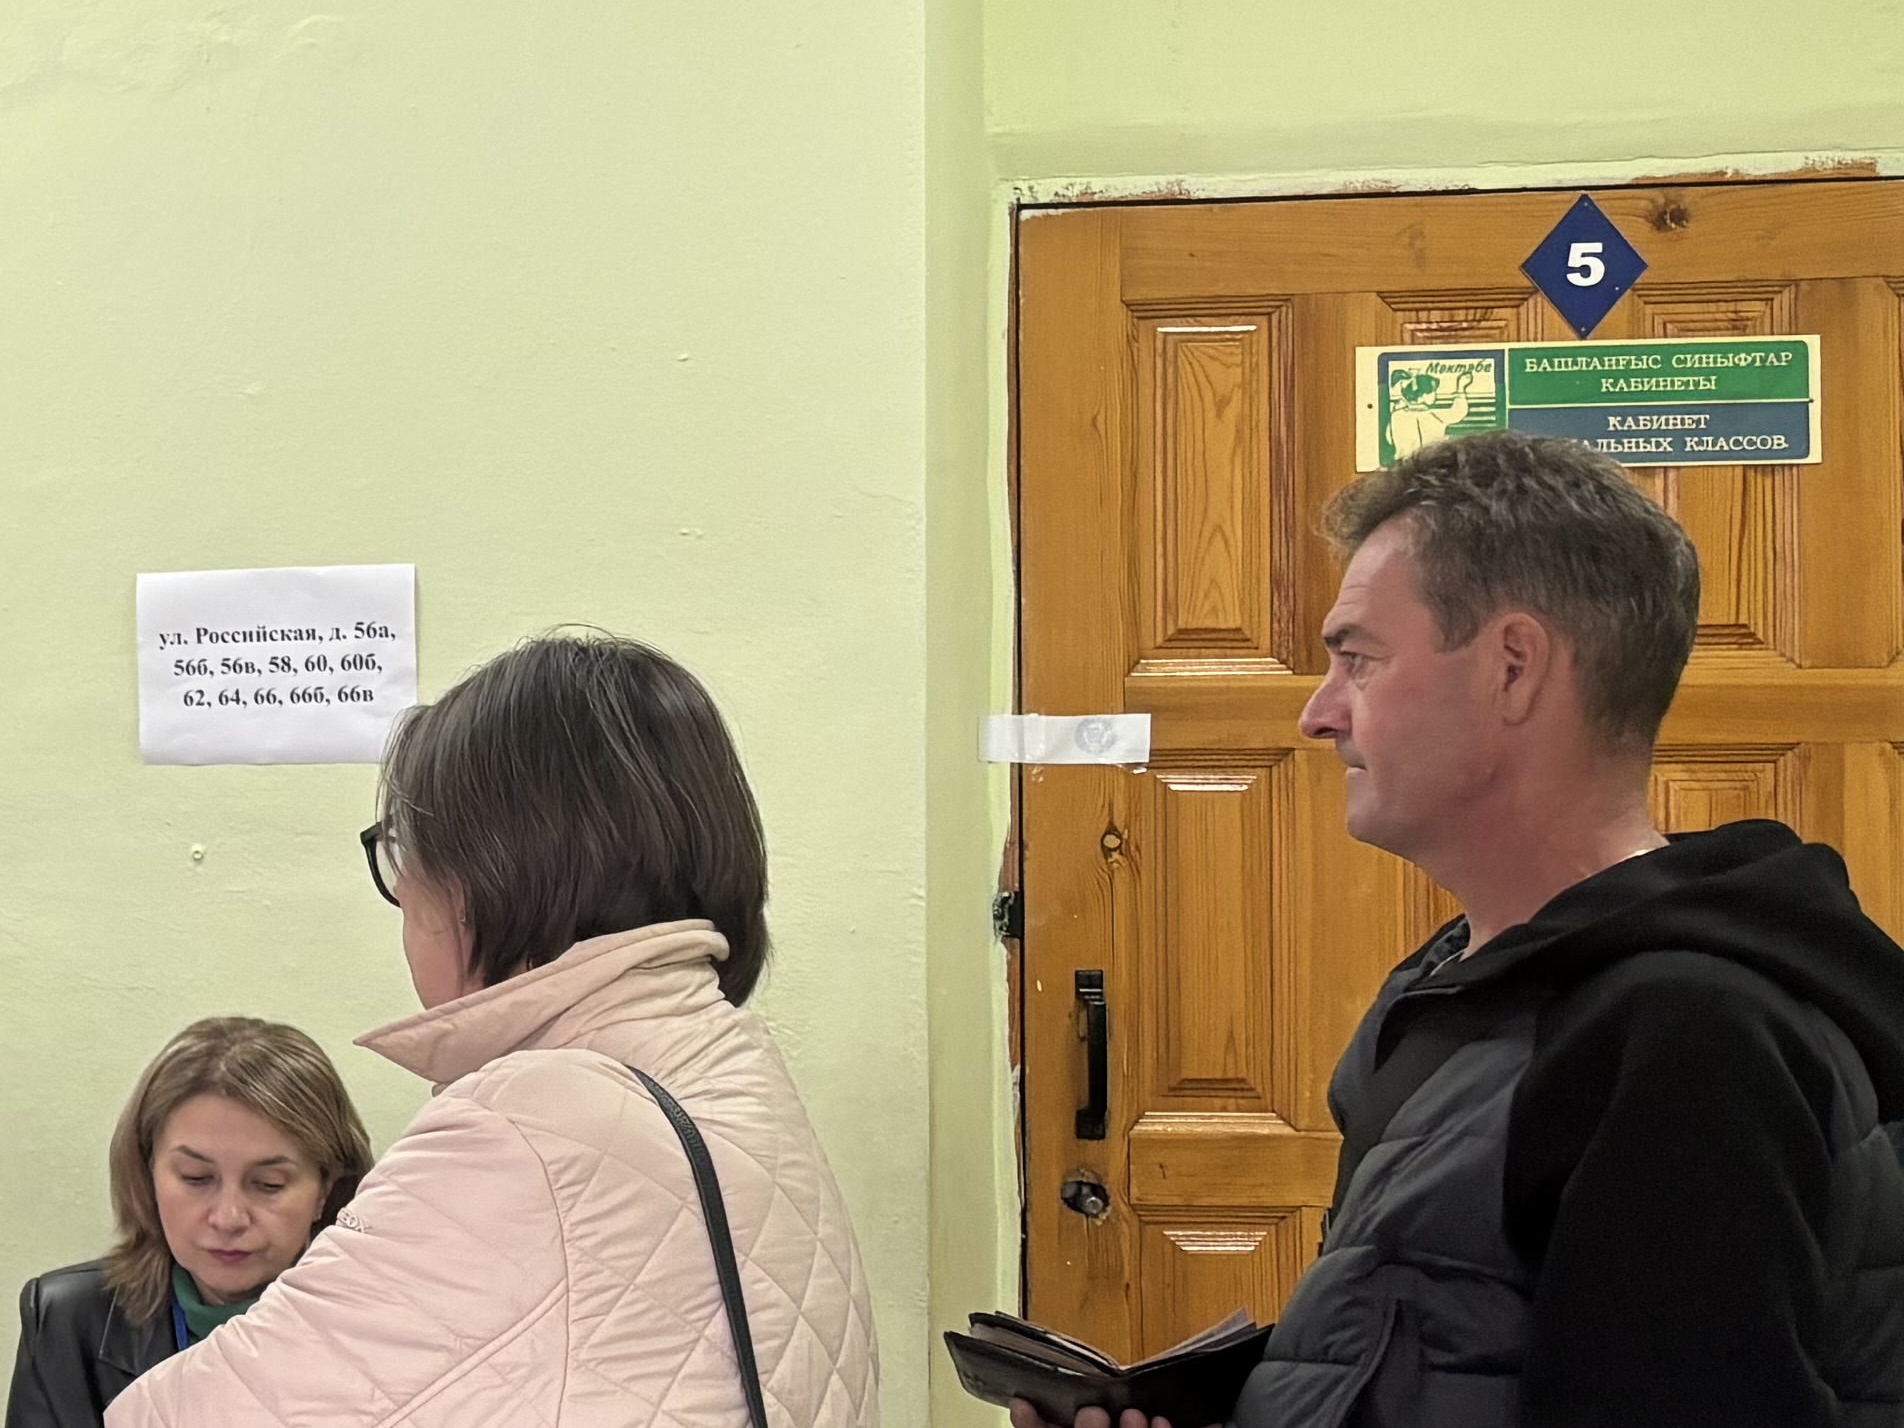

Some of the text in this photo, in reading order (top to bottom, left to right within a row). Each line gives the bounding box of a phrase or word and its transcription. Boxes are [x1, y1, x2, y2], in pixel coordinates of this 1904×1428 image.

[1566, 242, 1606, 287] 5
[1671, 352, 1793, 369] СИНЫФТАР
[1600, 376, 1718, 392] КАБИНЕТЫ
[1607, 414, 1711, 431] КАБИНЕТ
[1581, 437, 1674, 454] ЛЬНЫХ
[159, 621, 396, 650] ул. Российская, д. 56а,
[173, 653, 383, 677] 56б, 56в, 58, 60, 60б,
[183, 685, 374, 708] 62, 64, 66, 66б, 66в
